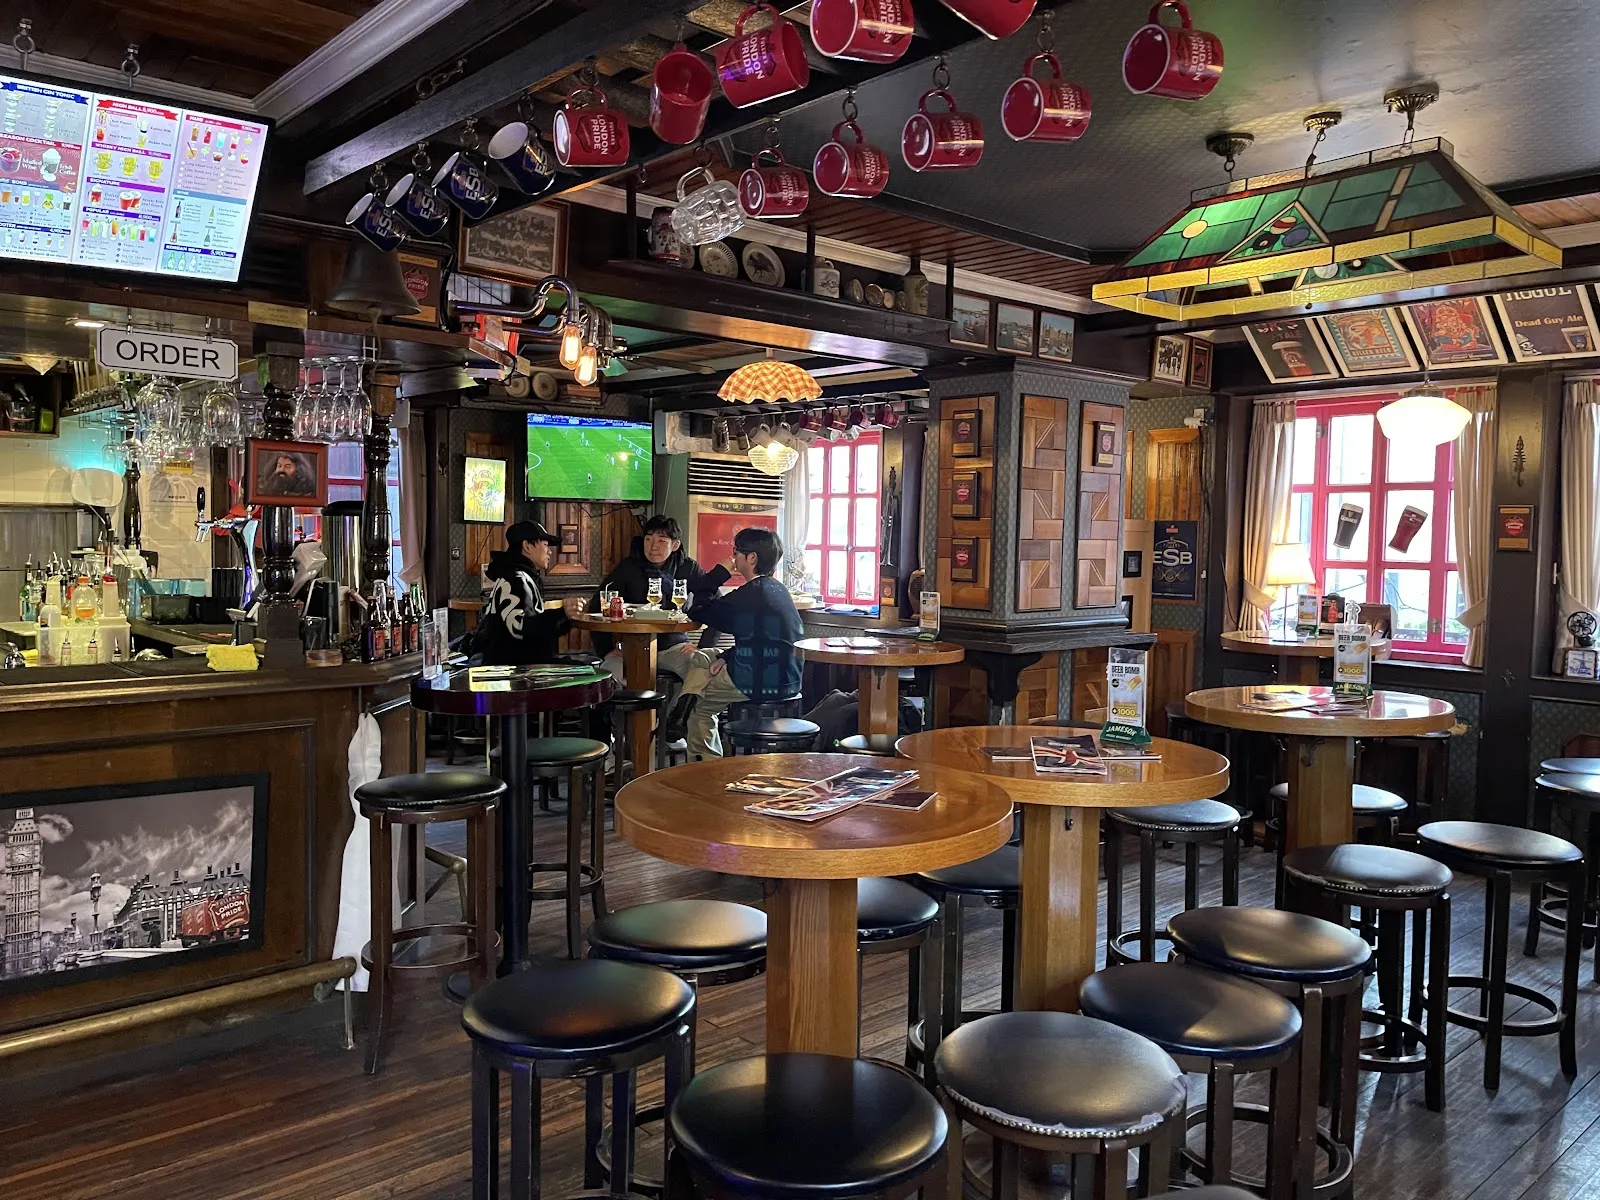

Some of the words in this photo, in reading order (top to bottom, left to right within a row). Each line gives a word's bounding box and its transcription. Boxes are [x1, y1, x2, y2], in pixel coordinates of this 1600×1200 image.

[742, 40, 754, 75] PRIDE
[591, 119, 601, 149] PRIDE
[597, 114, 608, 155] LONDON
[466, 167, 480, 201] ESB
[419, 188, 435, 220] ESB
[376, 209, 392, 237] ESB
[1515, 318, 1541, 328] Dead
[1544, 316, 1564, 326] Guy
[1566, 314, 1583, 322] Ale
[116, 339, 221, 370] ORDER
[1153, 548, 1193, 567] ESB
[1111, 665, 1124, 674] BEER
[1105, 725, 1138, 737] JAMESON
[215, 900, 245, 916] LONDON
[220, 906, 242, 919] PRIDE
